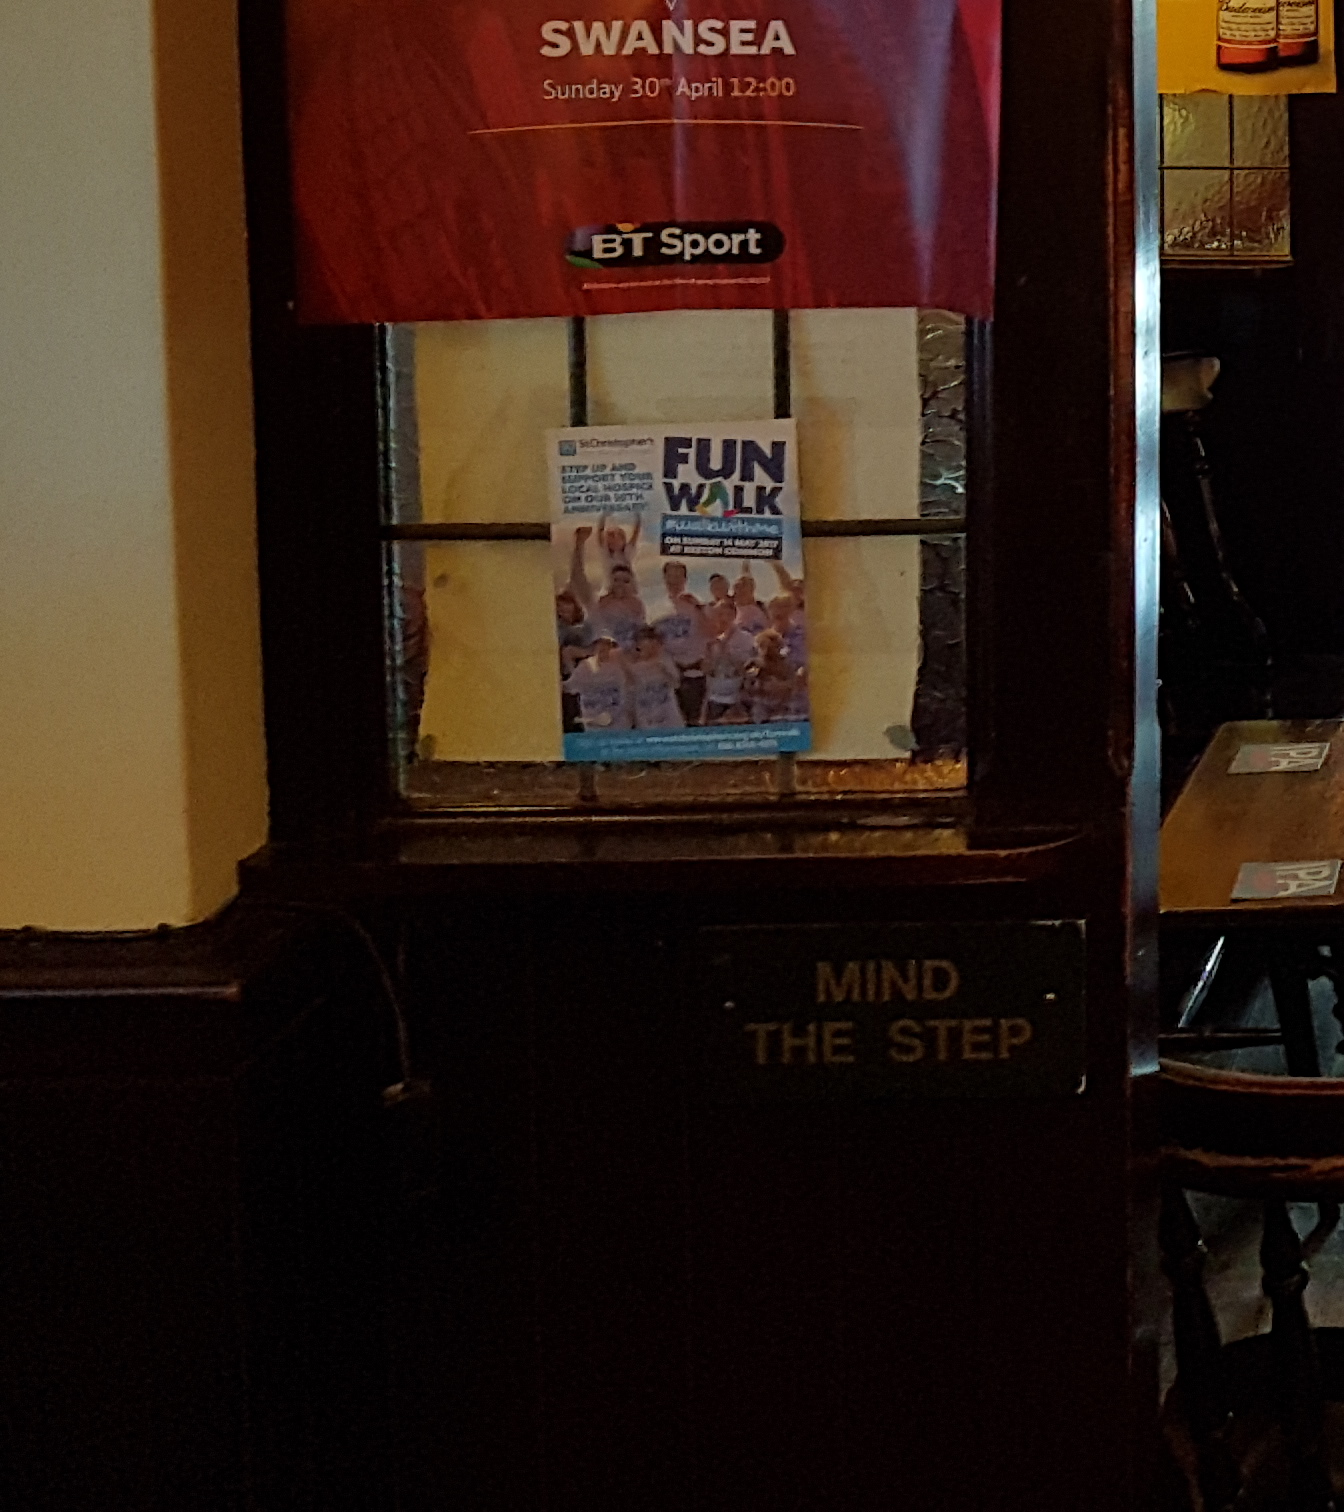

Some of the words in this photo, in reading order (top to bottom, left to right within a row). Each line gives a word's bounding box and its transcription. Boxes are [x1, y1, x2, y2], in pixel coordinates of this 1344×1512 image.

[539, 19, 796, 58] SWANSEA
[543, 78, 623, 102] Sunday
[674, 77, 723, 100] April
[729, 77, 795, 97] 12:00
[591, 233, 653, 259] BT
[659, 228, 762, 262] Sport
[663, 436, 787, 484] FUN
[1275, 860, 1336, 896] IPA
[815, 958, 960, 1003] MIND
[744, 1020, 856, 1065] THE
[888, 1017, 1034, 1063] STEP
